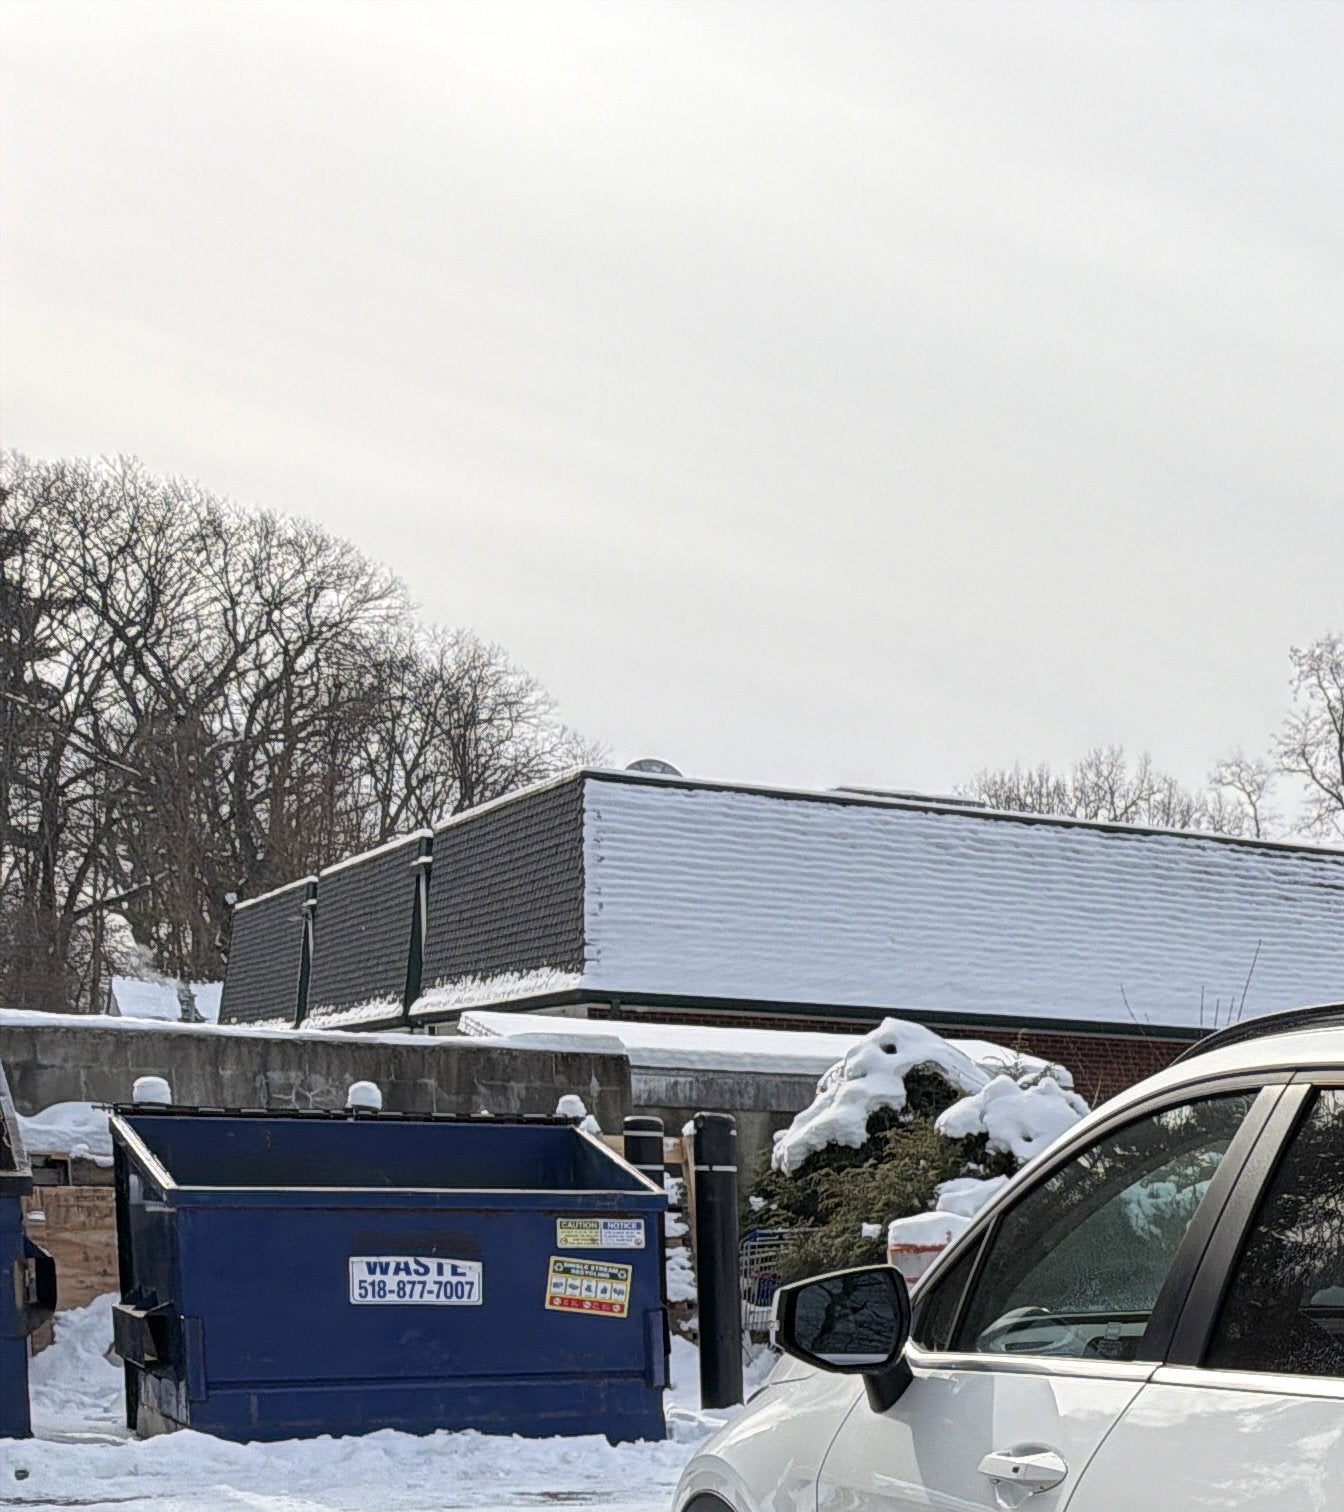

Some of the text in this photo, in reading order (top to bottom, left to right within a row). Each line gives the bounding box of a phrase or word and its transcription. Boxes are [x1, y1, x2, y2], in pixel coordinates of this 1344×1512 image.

[561, 1220, 598, 1229] CAUTION
[607, 1222, 637, 1230] NOTICE
[358, 1279, 475, 1300] 518-877-7007
